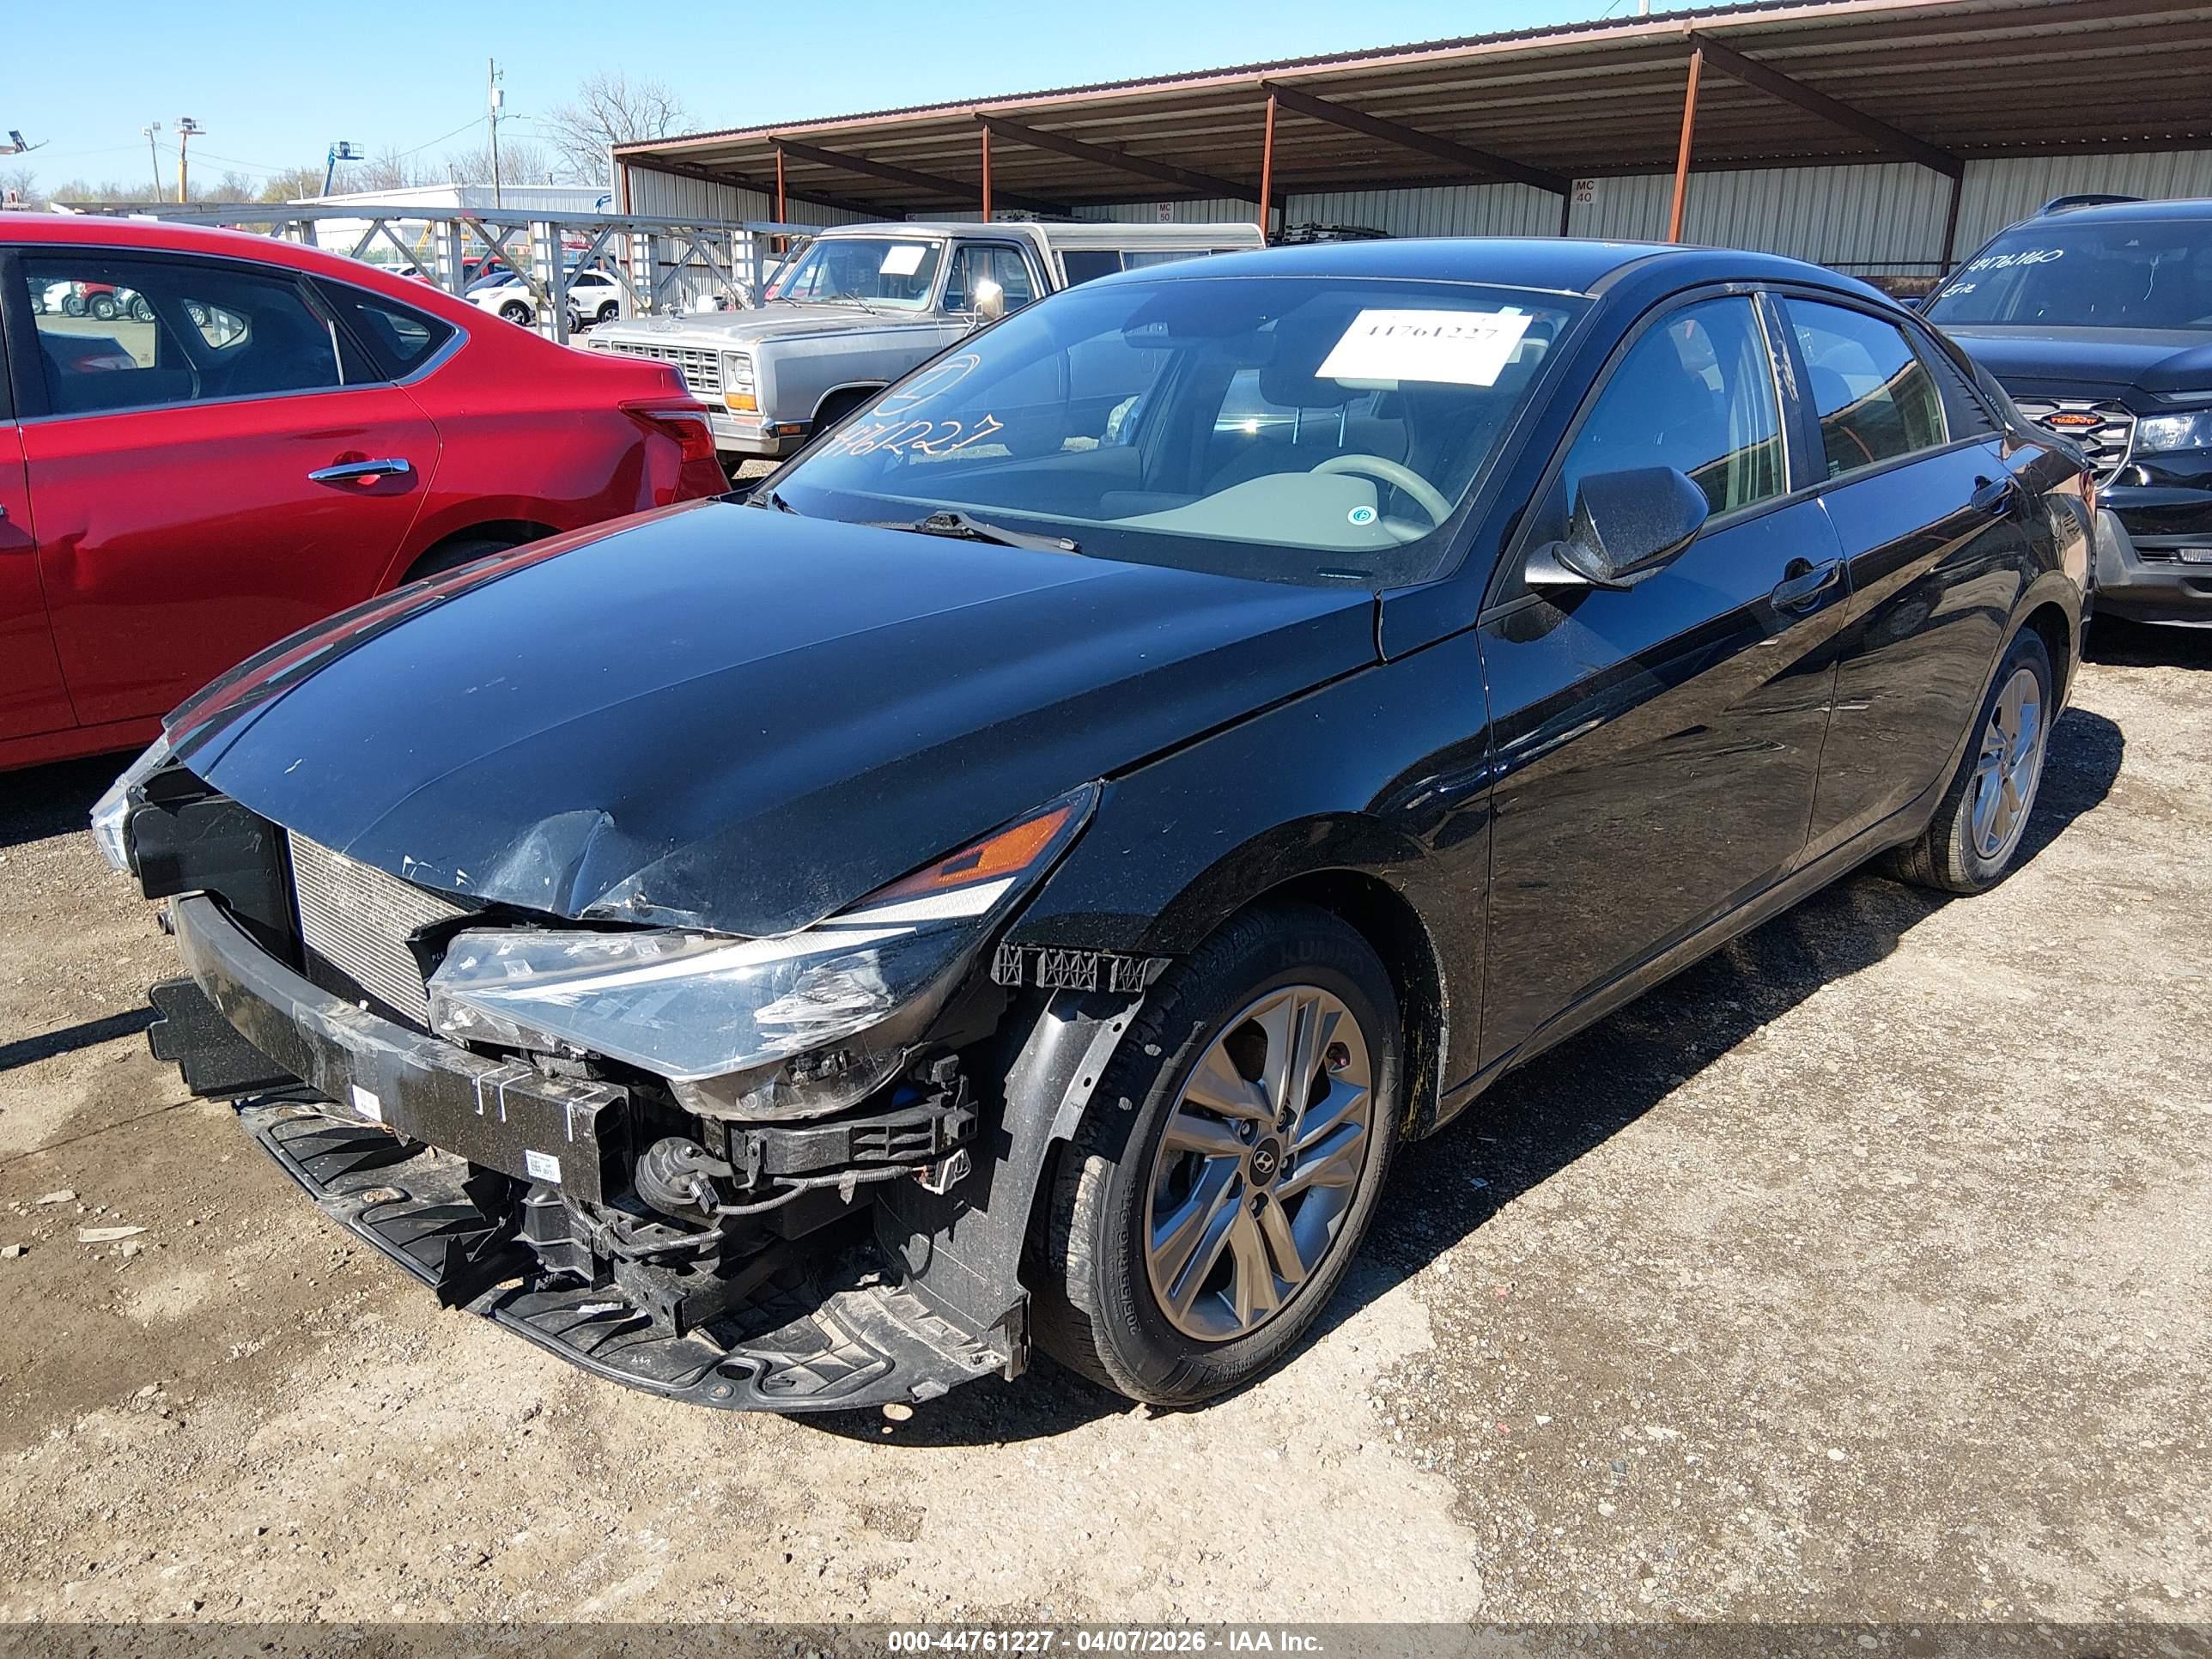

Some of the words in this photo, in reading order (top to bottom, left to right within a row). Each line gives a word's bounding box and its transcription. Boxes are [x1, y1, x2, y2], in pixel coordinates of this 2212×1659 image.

[1576, 180, 1595, 191] MC
[1577, 192, 1592, 203] 40
[1159, 204, 1171, 212] MC
[1967, 249, 2063, 272] 44761160
